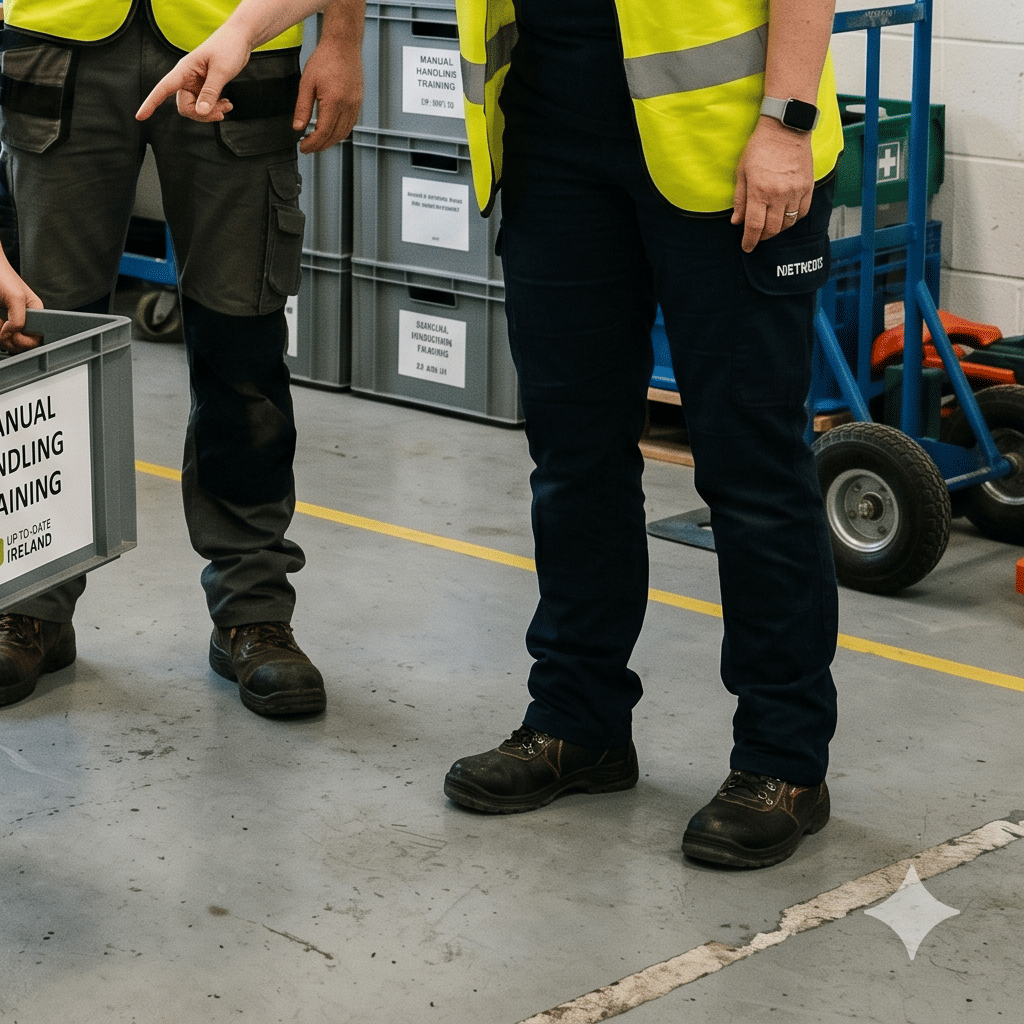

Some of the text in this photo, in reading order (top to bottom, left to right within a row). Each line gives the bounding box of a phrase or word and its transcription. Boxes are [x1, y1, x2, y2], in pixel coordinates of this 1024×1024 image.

[420, 55, 453, 66] MANUAL
[417, 79, 456, 91] TRAINING
[7, 532, 52, 564] IRELAND
